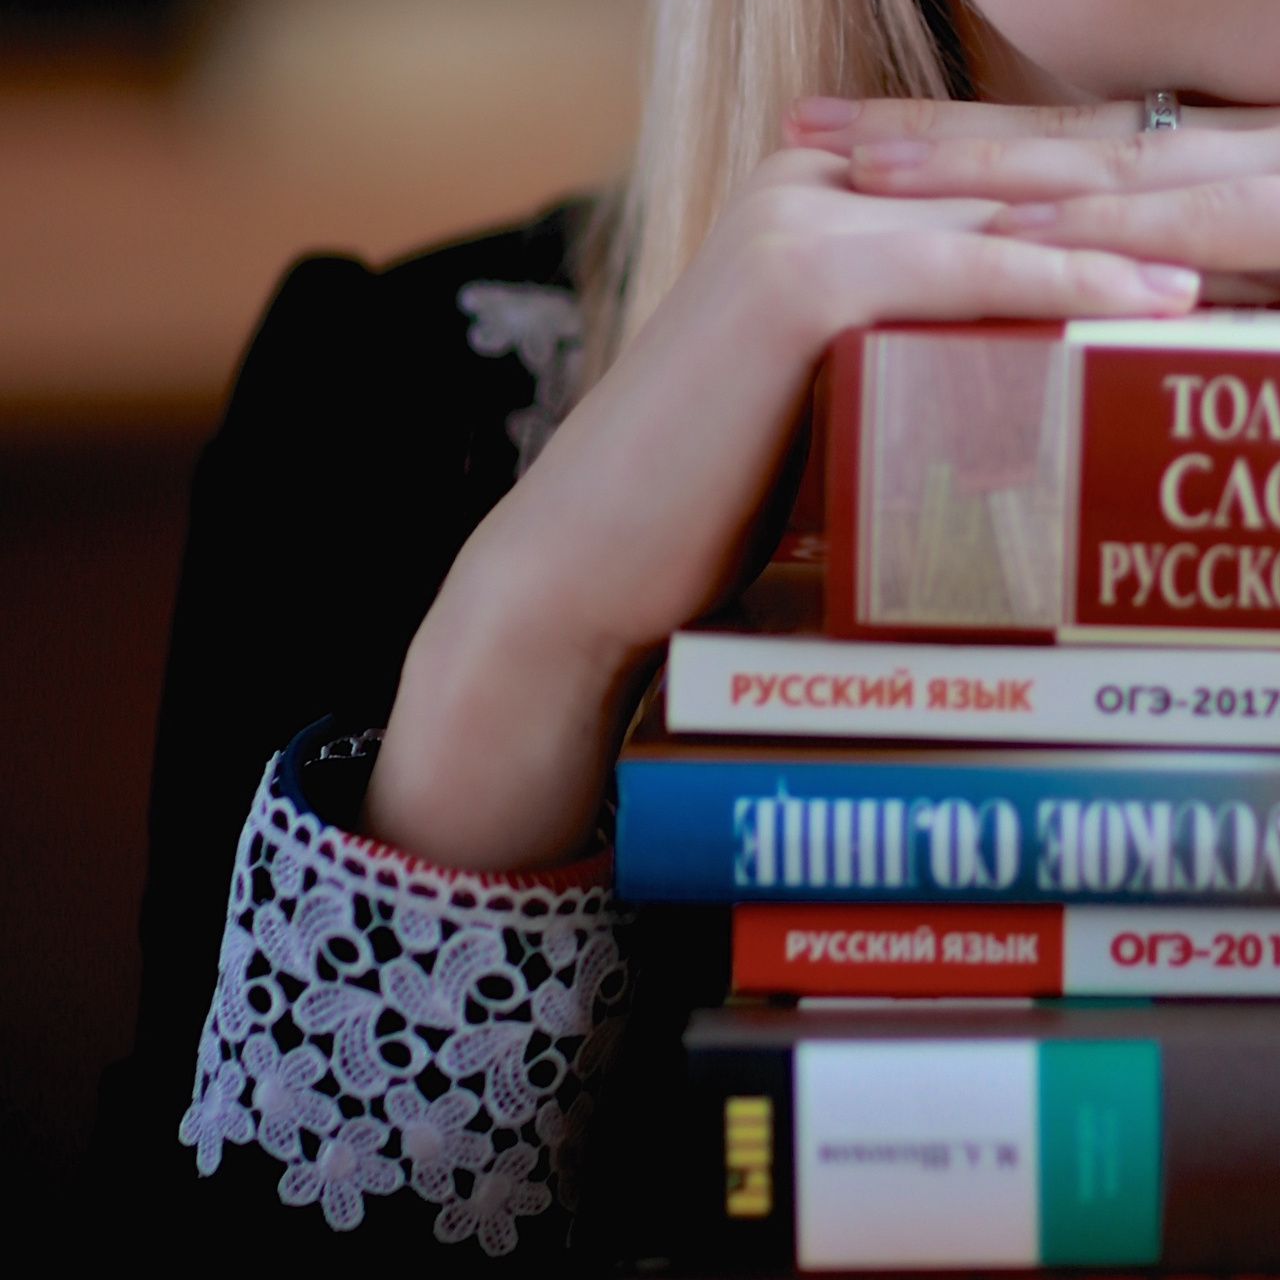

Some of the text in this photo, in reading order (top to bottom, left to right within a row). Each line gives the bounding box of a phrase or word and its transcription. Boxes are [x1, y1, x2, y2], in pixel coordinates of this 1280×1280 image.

[730, 667, 1035, 712] РУССКИЙ ЯЗЫК
[734, 776, 1020, 890] СОЛНЦЕ
[785, 925, 1040, 965] РУССКИЙ ЯЗЫК
